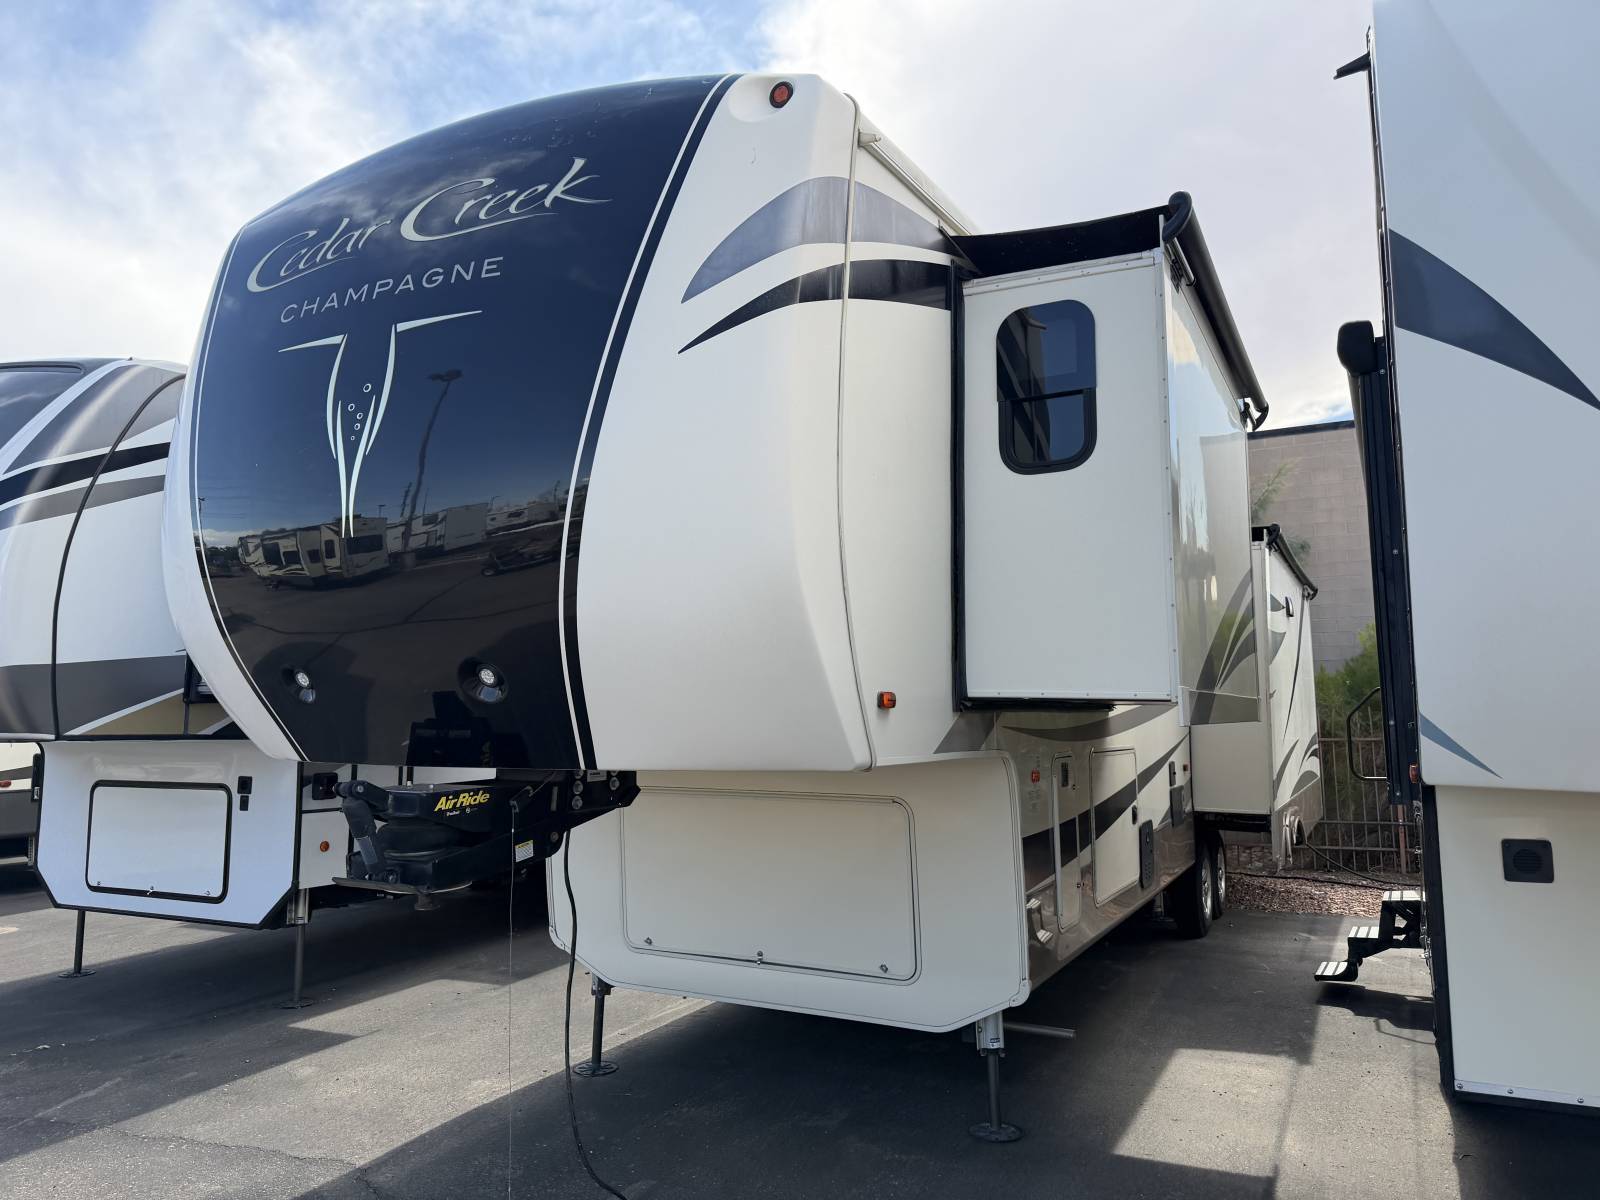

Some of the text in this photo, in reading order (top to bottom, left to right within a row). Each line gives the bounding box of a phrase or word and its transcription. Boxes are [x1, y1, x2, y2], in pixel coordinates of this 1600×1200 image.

[246, 156, 613, 292] Cedar Creek
[280, 256, 504, 323] CHAMPAGNE
